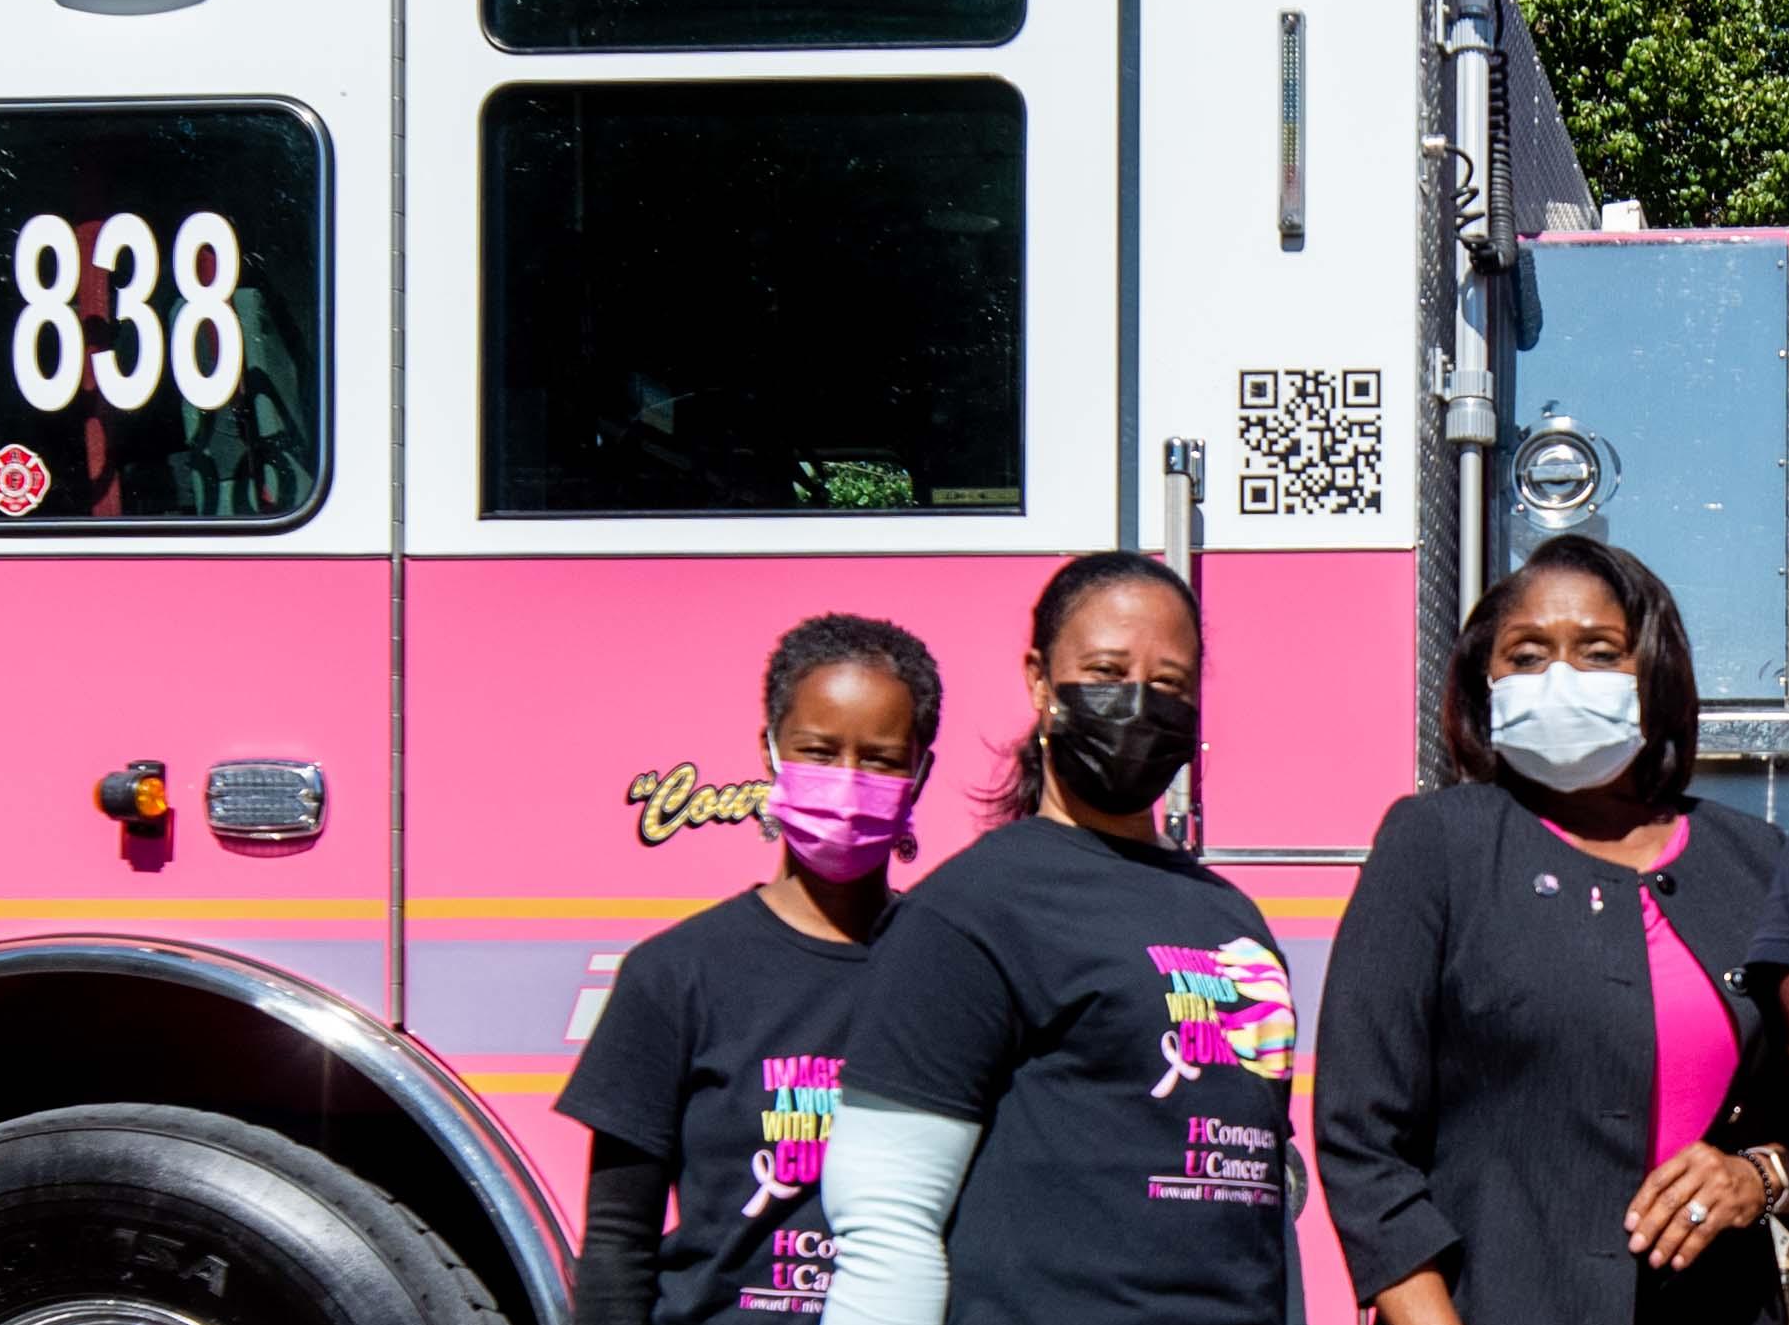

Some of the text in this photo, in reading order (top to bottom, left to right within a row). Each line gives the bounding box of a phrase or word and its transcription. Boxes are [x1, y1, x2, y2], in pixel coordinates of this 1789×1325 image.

[12, 212, 244, 411] 838
[761, 1110, 817, 1142] WITH
[1148, 1183, 1203, 1201] Howard
[739, 1293, 790, 1313] Howard
